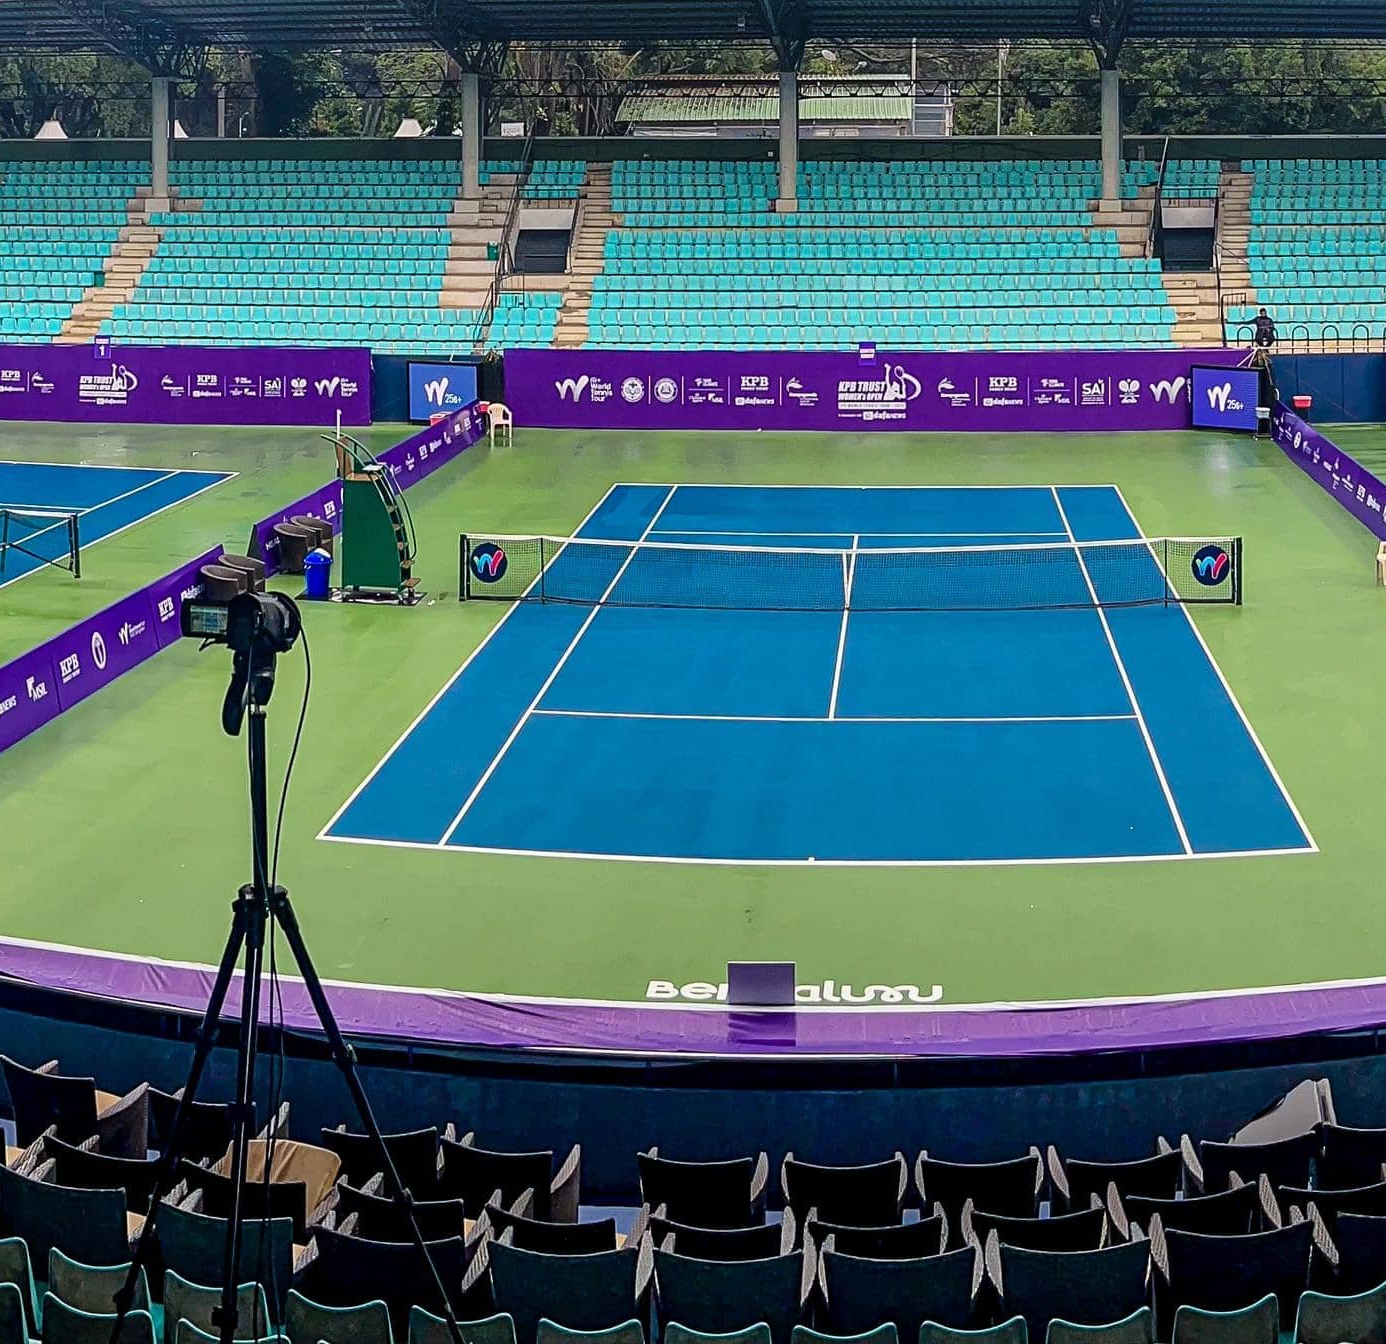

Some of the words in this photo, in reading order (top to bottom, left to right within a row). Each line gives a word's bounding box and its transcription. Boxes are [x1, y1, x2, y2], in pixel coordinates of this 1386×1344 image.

[98, 345, 105, 356] 1
[740, 376, 769, 387] KPB
[857, 381, 886, 392] TRUST
[988, 376, 1018, 387] KPB
[59, 653, 80, 678] KPB
